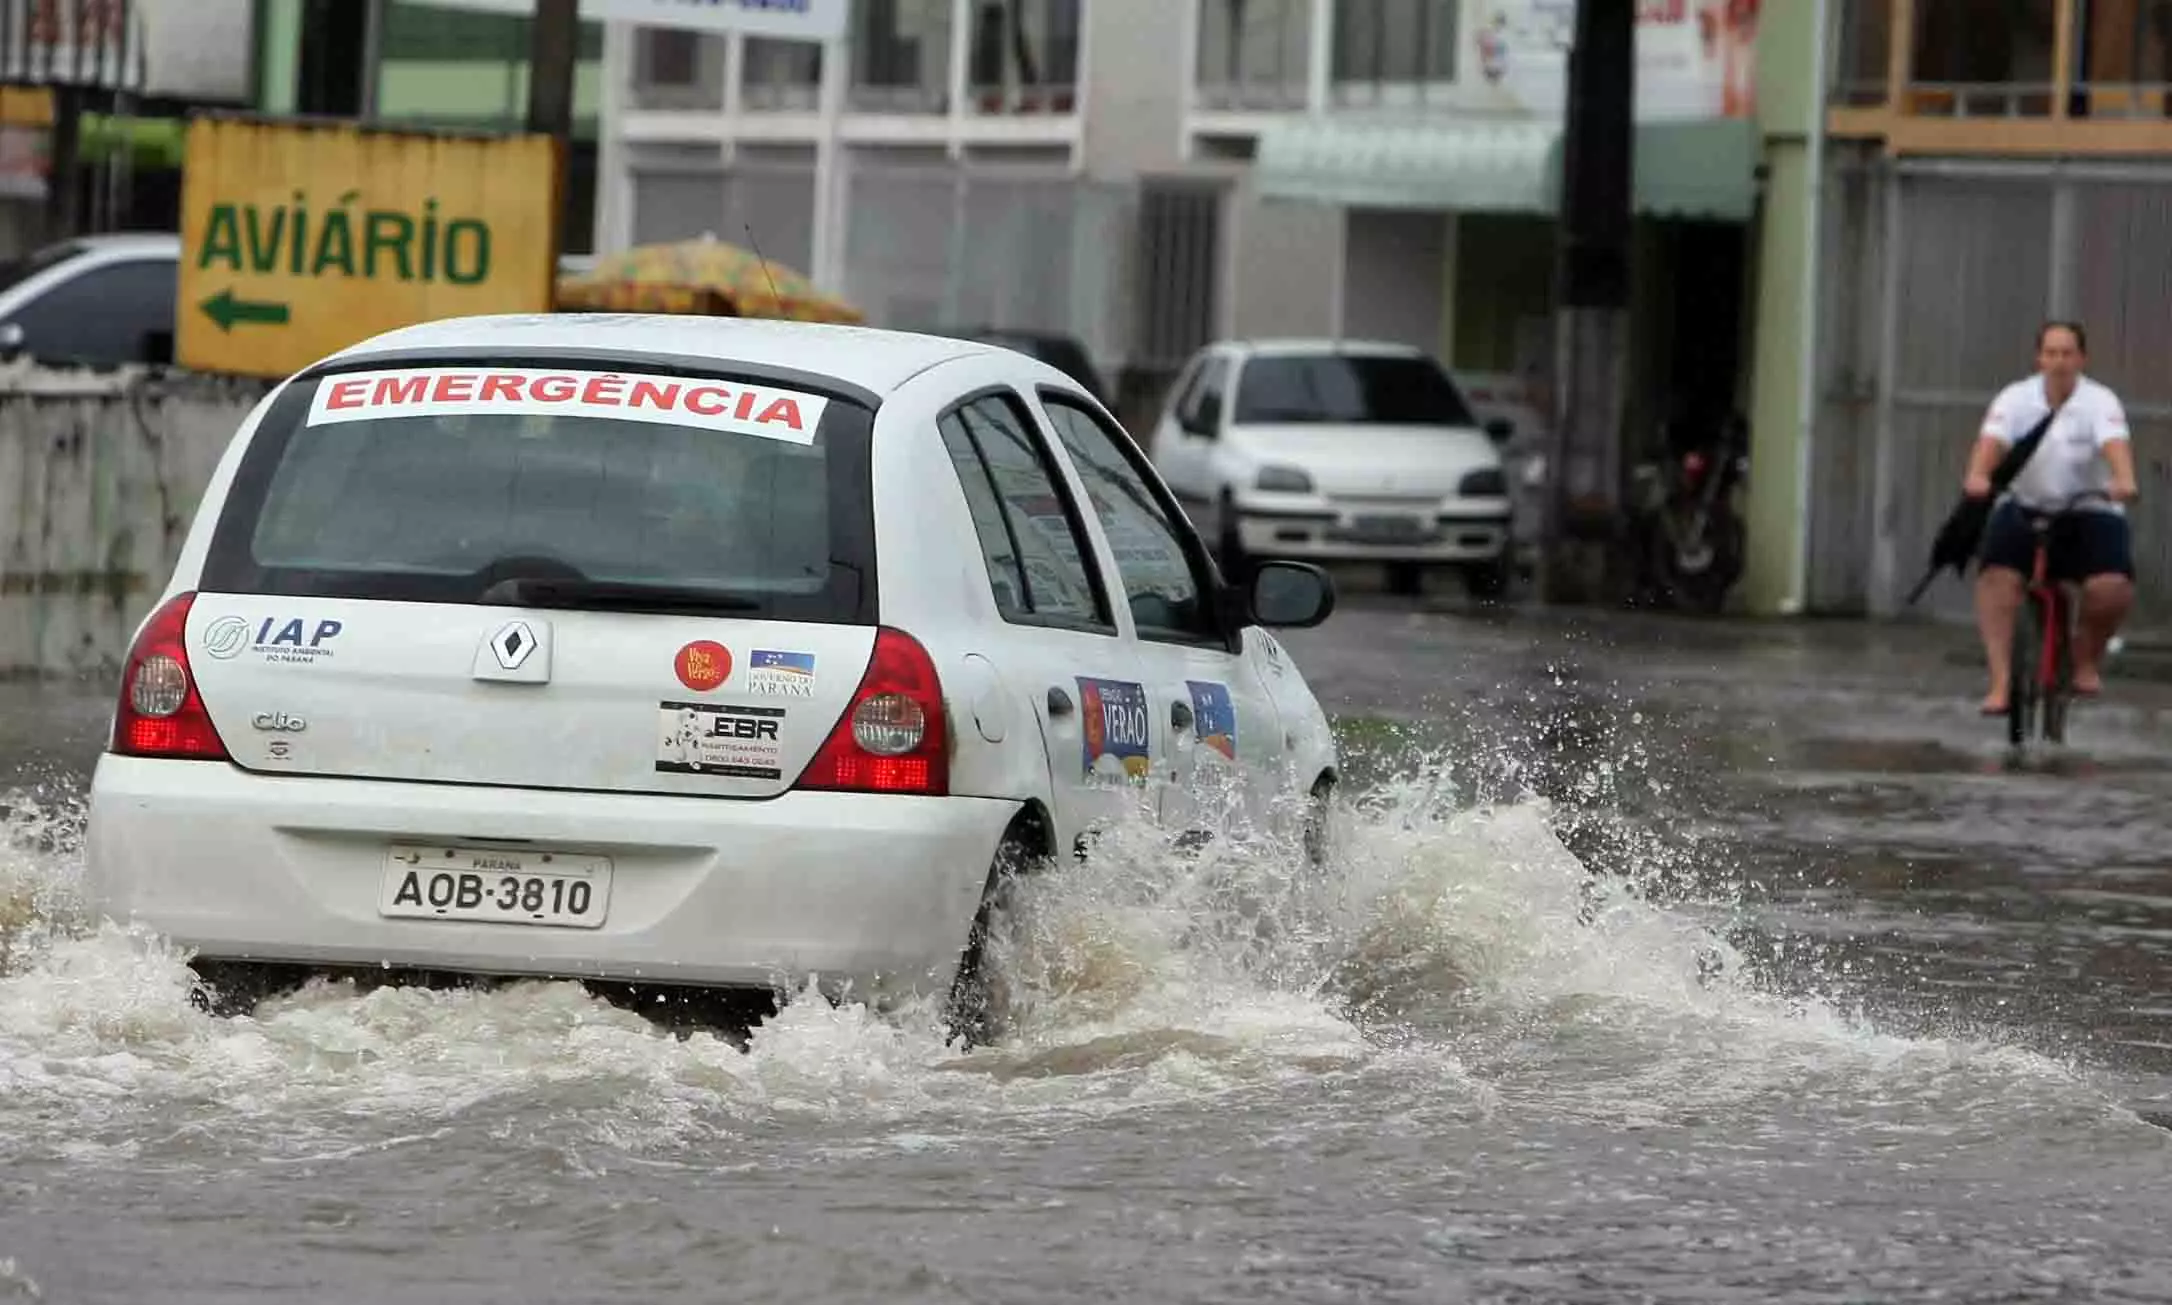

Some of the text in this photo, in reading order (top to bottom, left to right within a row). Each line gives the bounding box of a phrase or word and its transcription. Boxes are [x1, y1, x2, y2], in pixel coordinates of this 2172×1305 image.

[325, 374, 805, 431] EMERGÊNCIA
[255, 616, 343, 647] IAP
[252, 711, 307, 733] Clio
[713, 716, 778, 741] EBR
[392, 870, 593, 916] AOB-3810
